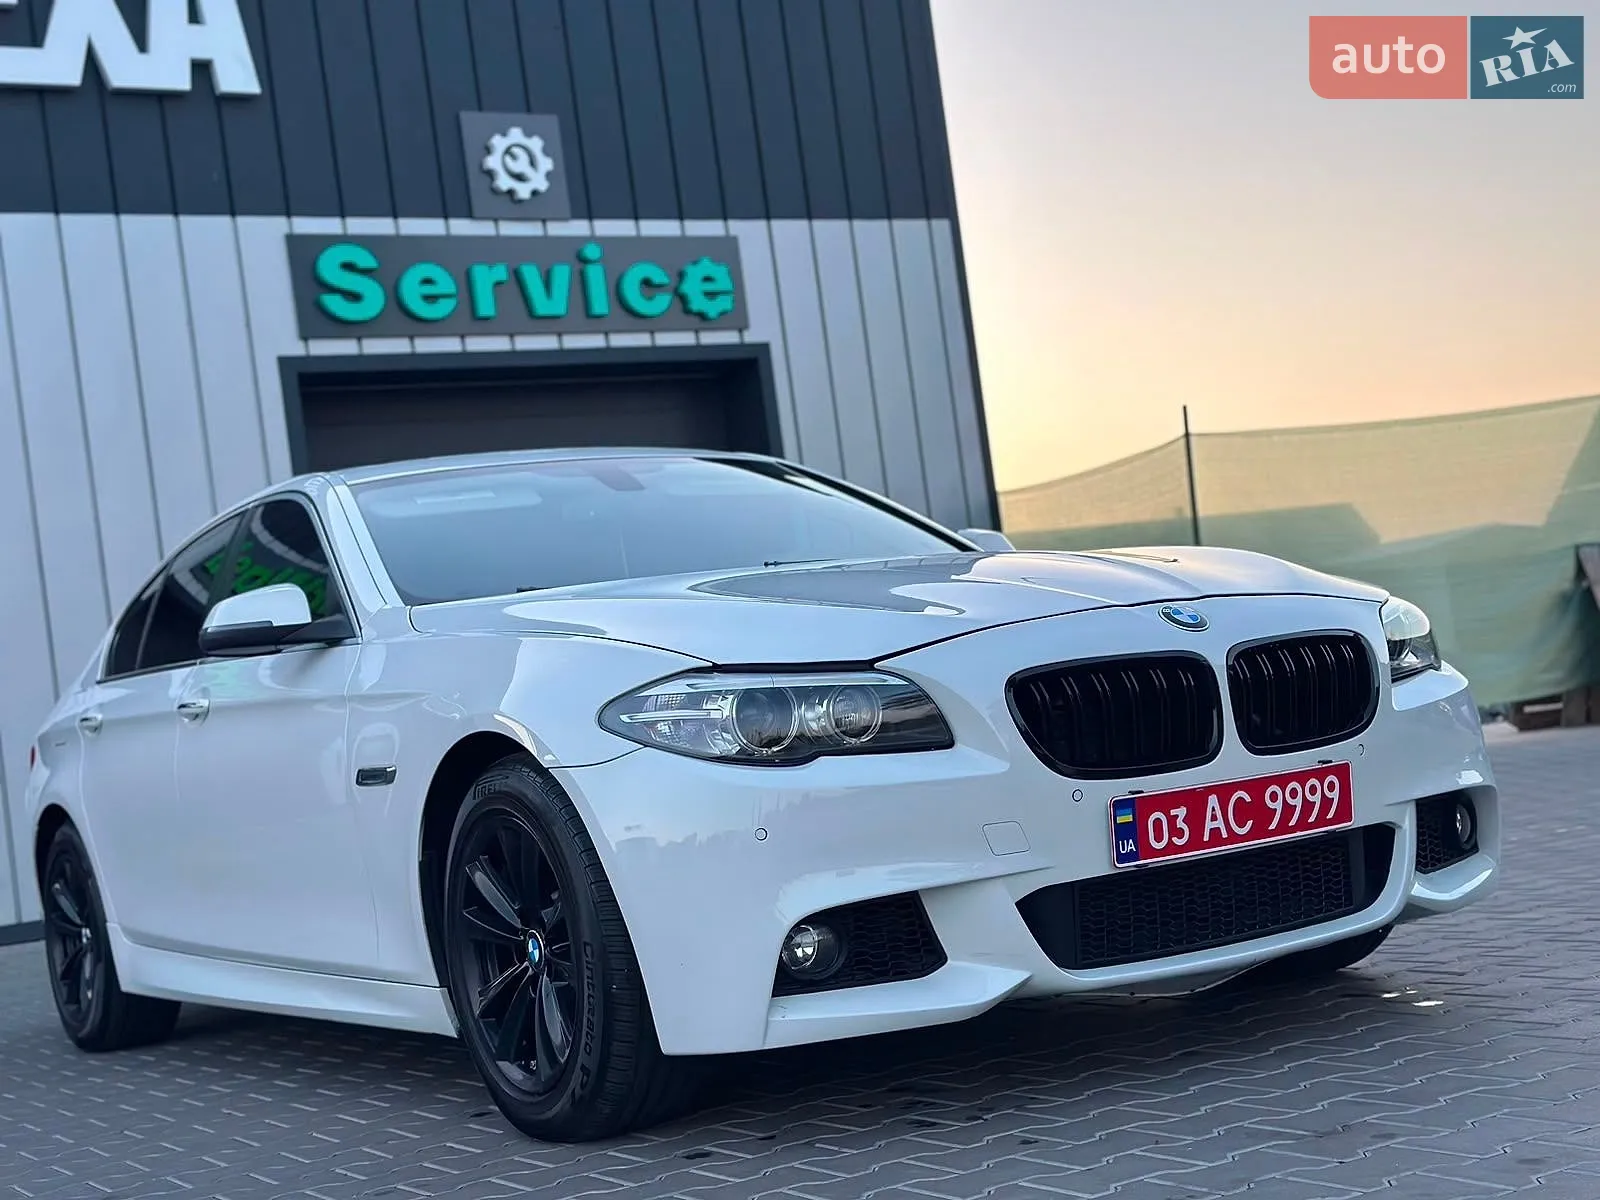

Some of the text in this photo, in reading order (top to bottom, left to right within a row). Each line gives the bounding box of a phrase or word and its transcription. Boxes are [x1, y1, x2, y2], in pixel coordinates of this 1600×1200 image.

[314, 242, 735, 323] Service
[1119, 838, 1136, 854] UA
[1147, 774, 1340, 849] 03 AC 9999
